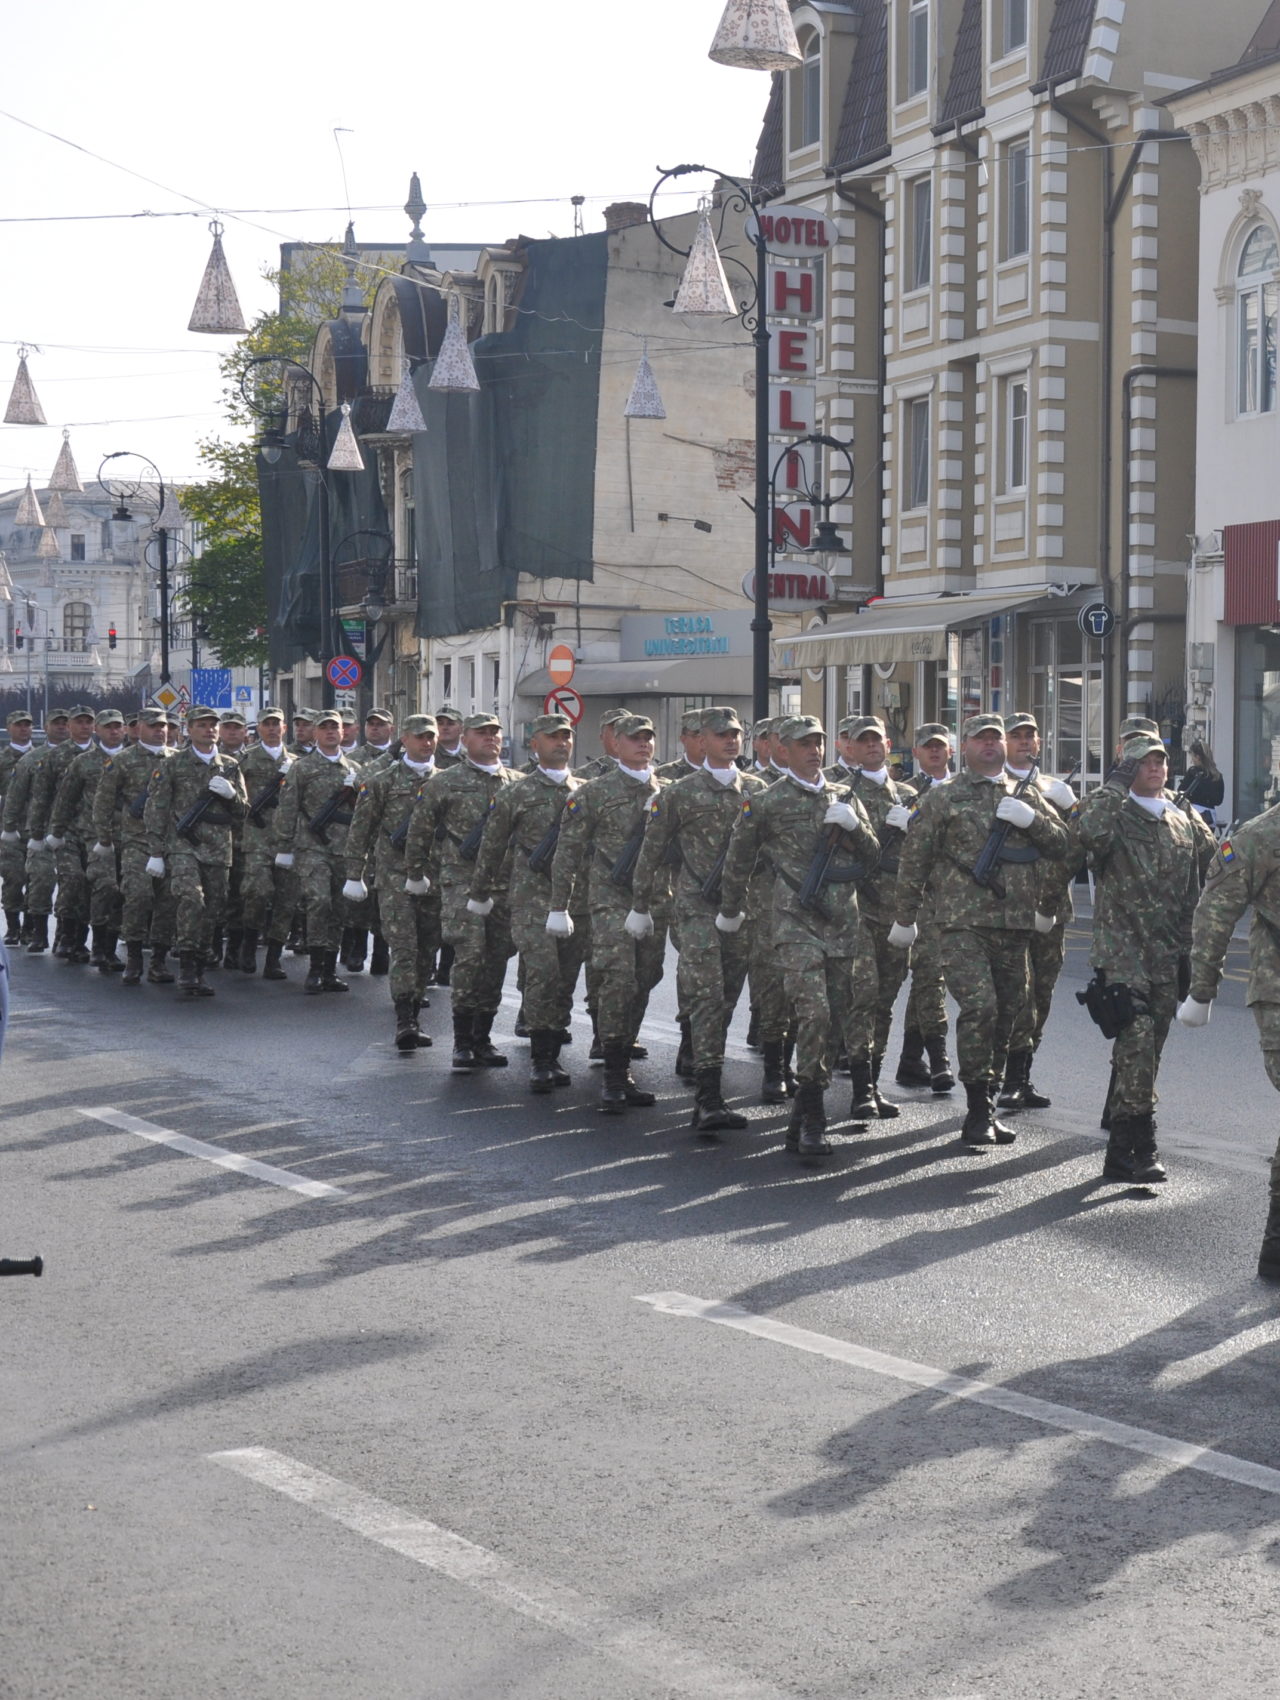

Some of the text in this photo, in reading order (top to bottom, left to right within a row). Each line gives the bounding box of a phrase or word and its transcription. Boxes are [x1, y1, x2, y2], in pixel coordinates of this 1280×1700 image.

[759, 215, 829, 247] HOTEL
[773, 271, 813, 549] HELIN
[752, 573, 830, 600] ENTRAL
[664, 615, 714, 634] TERASA
